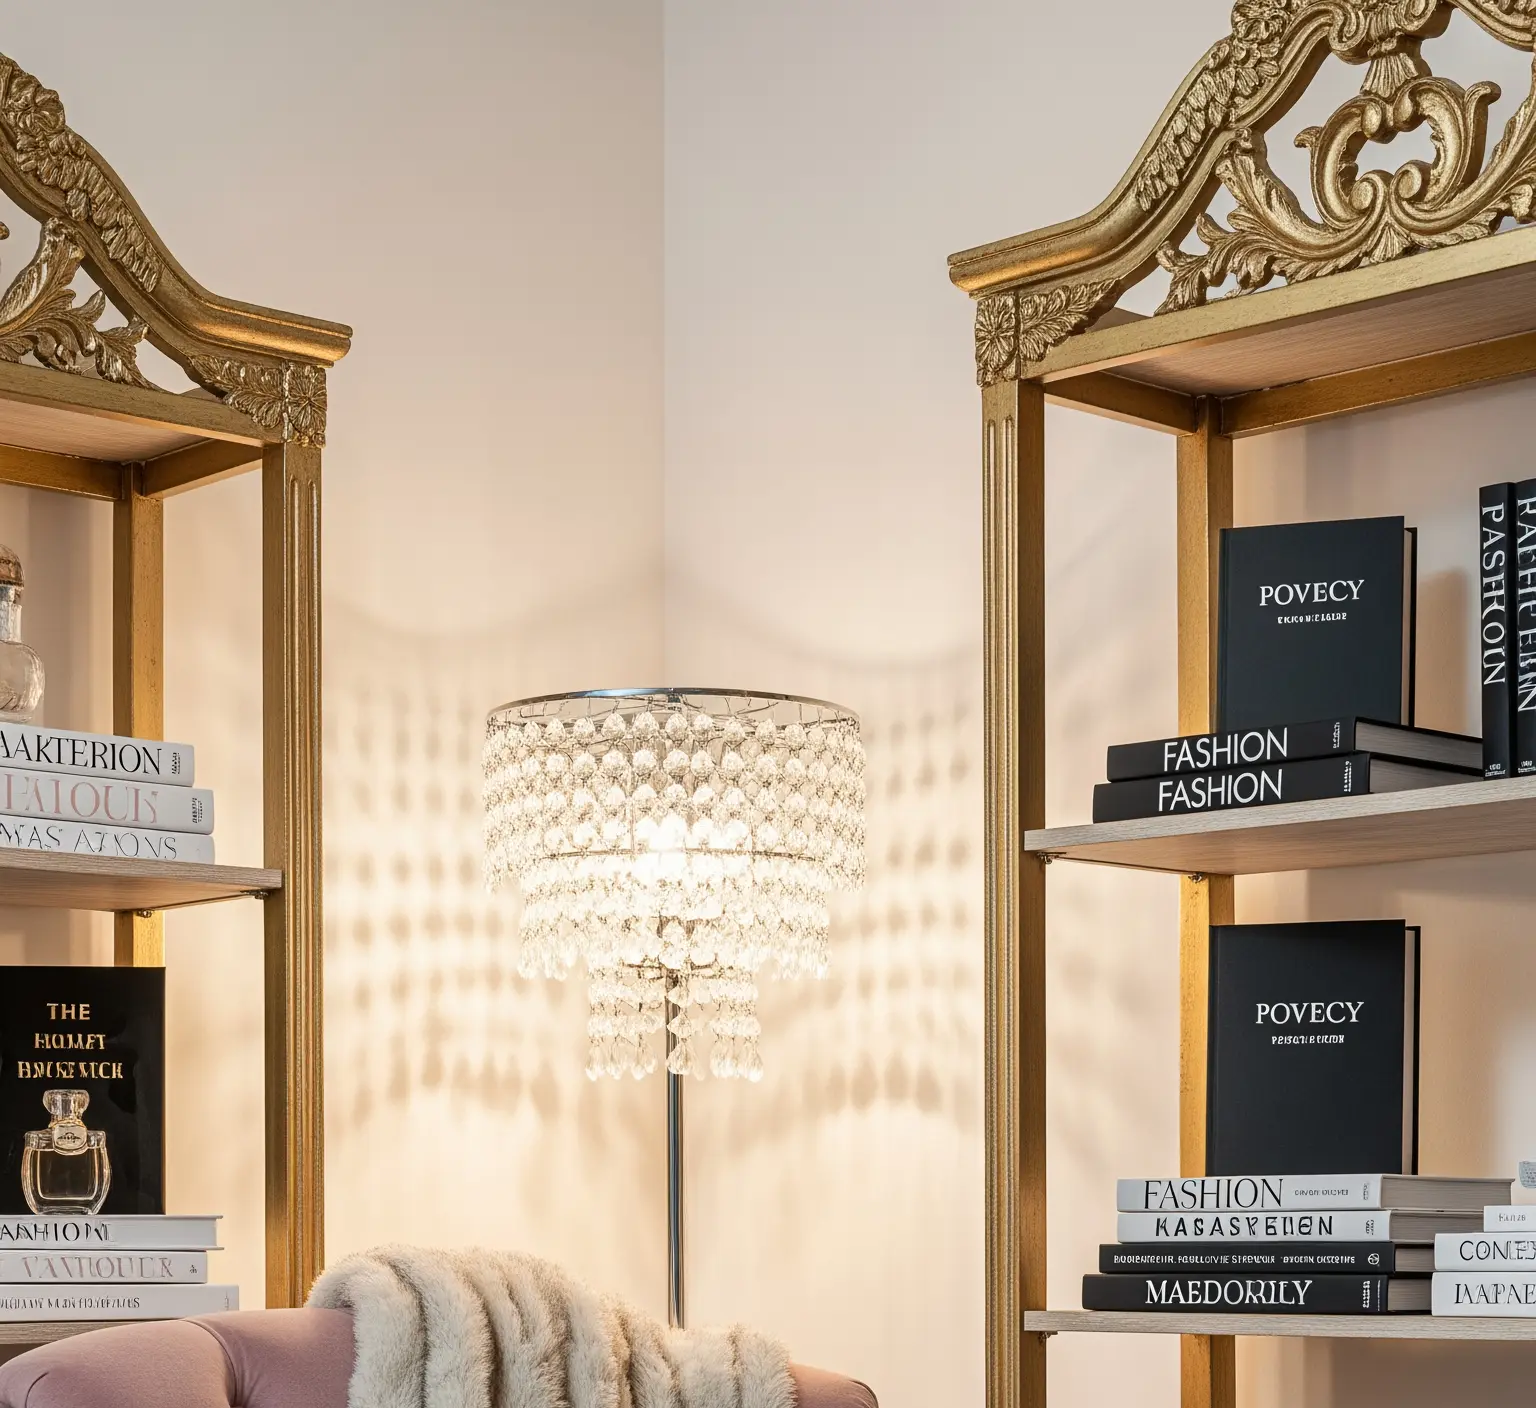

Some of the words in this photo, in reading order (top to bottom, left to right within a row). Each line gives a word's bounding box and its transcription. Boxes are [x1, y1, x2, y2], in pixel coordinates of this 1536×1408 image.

[1259, 579, 1365, 606] POVECY
[1164, 727, 1288, 772] FASHION
[1158, 768, 1283, 812] FASHION
[46, 1002, 91, 1020] THE
[1255, 1001, 1365, 1025] POVECY
[1144, 1178, 1284, 1210] FASHION
